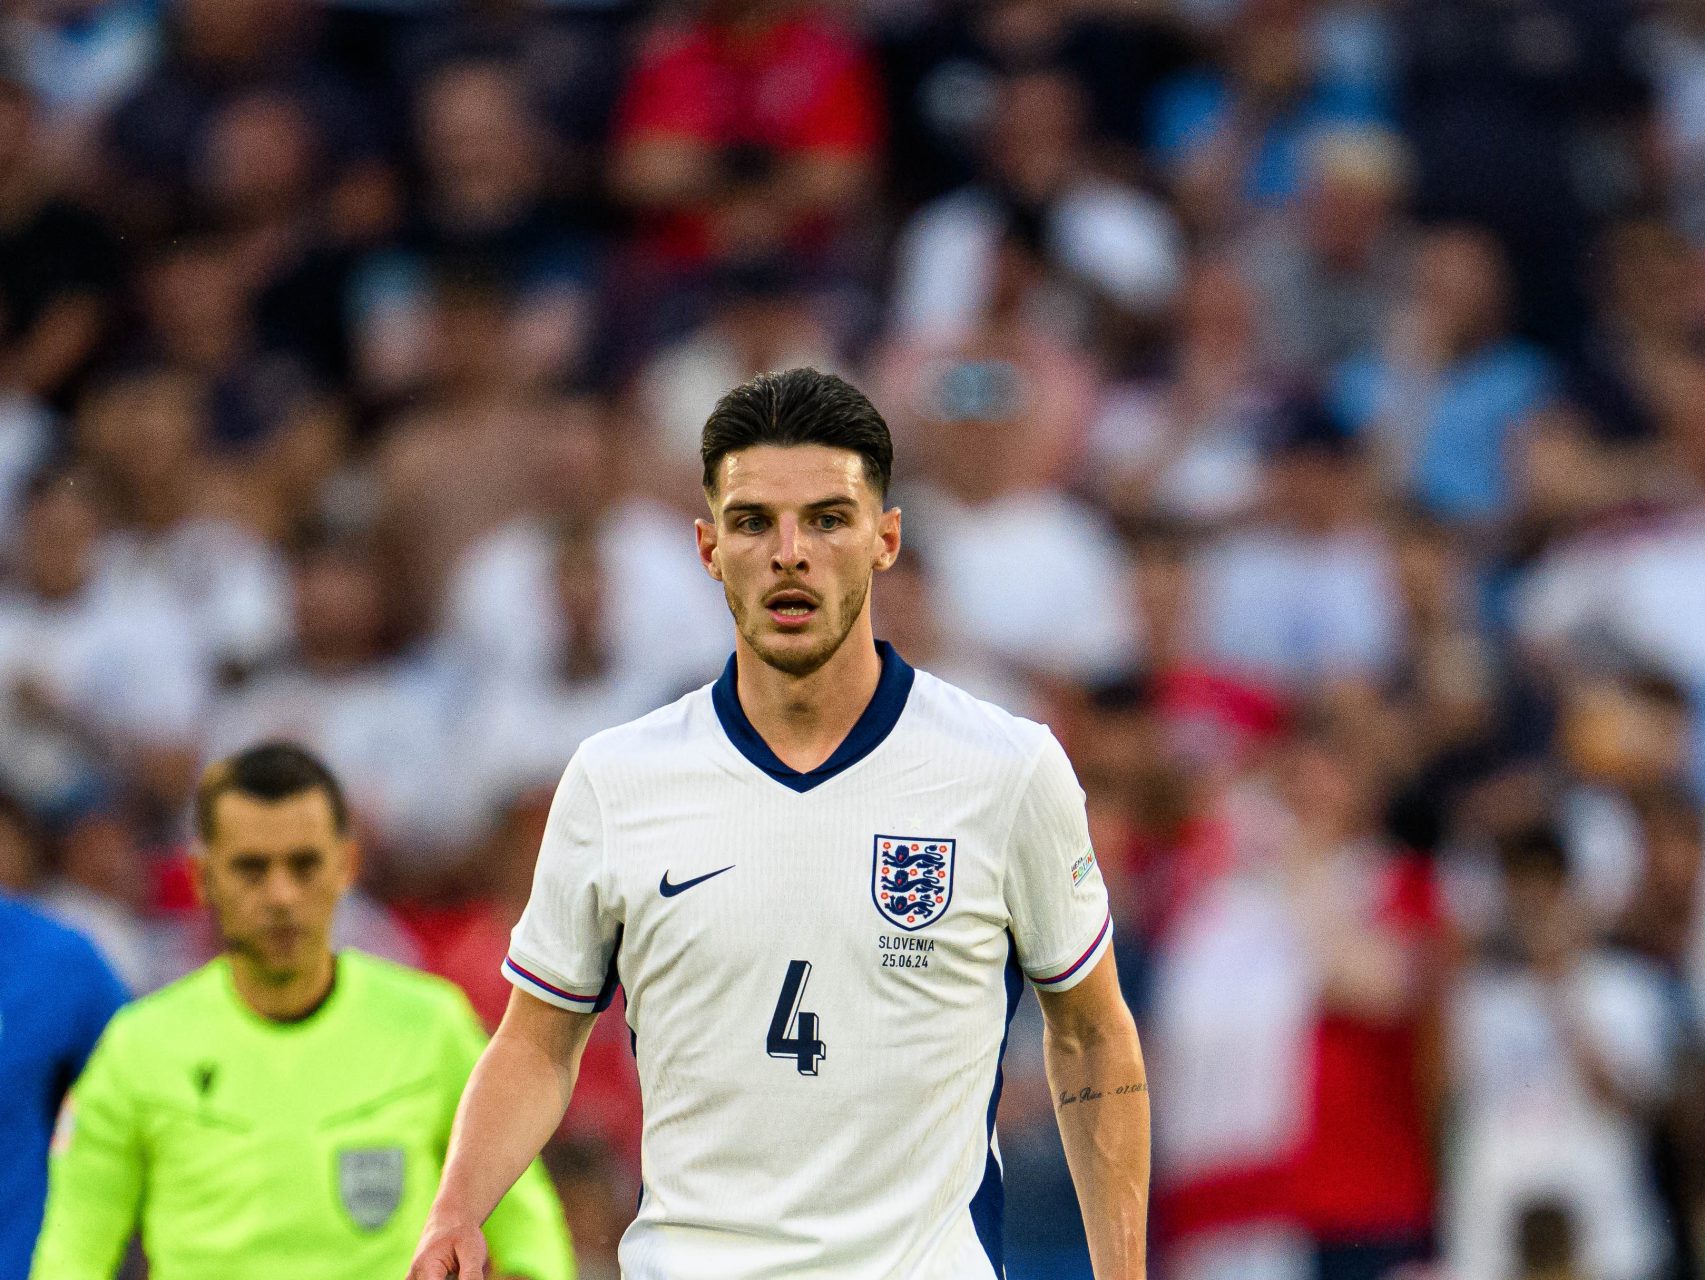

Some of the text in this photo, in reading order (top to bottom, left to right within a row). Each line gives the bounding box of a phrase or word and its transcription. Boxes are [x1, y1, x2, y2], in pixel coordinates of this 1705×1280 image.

[878, 935, 935, 952] SLOVENIA
[881, 953, 928, 968] 25.06.24
[766, 959, 826, 1076] 4
